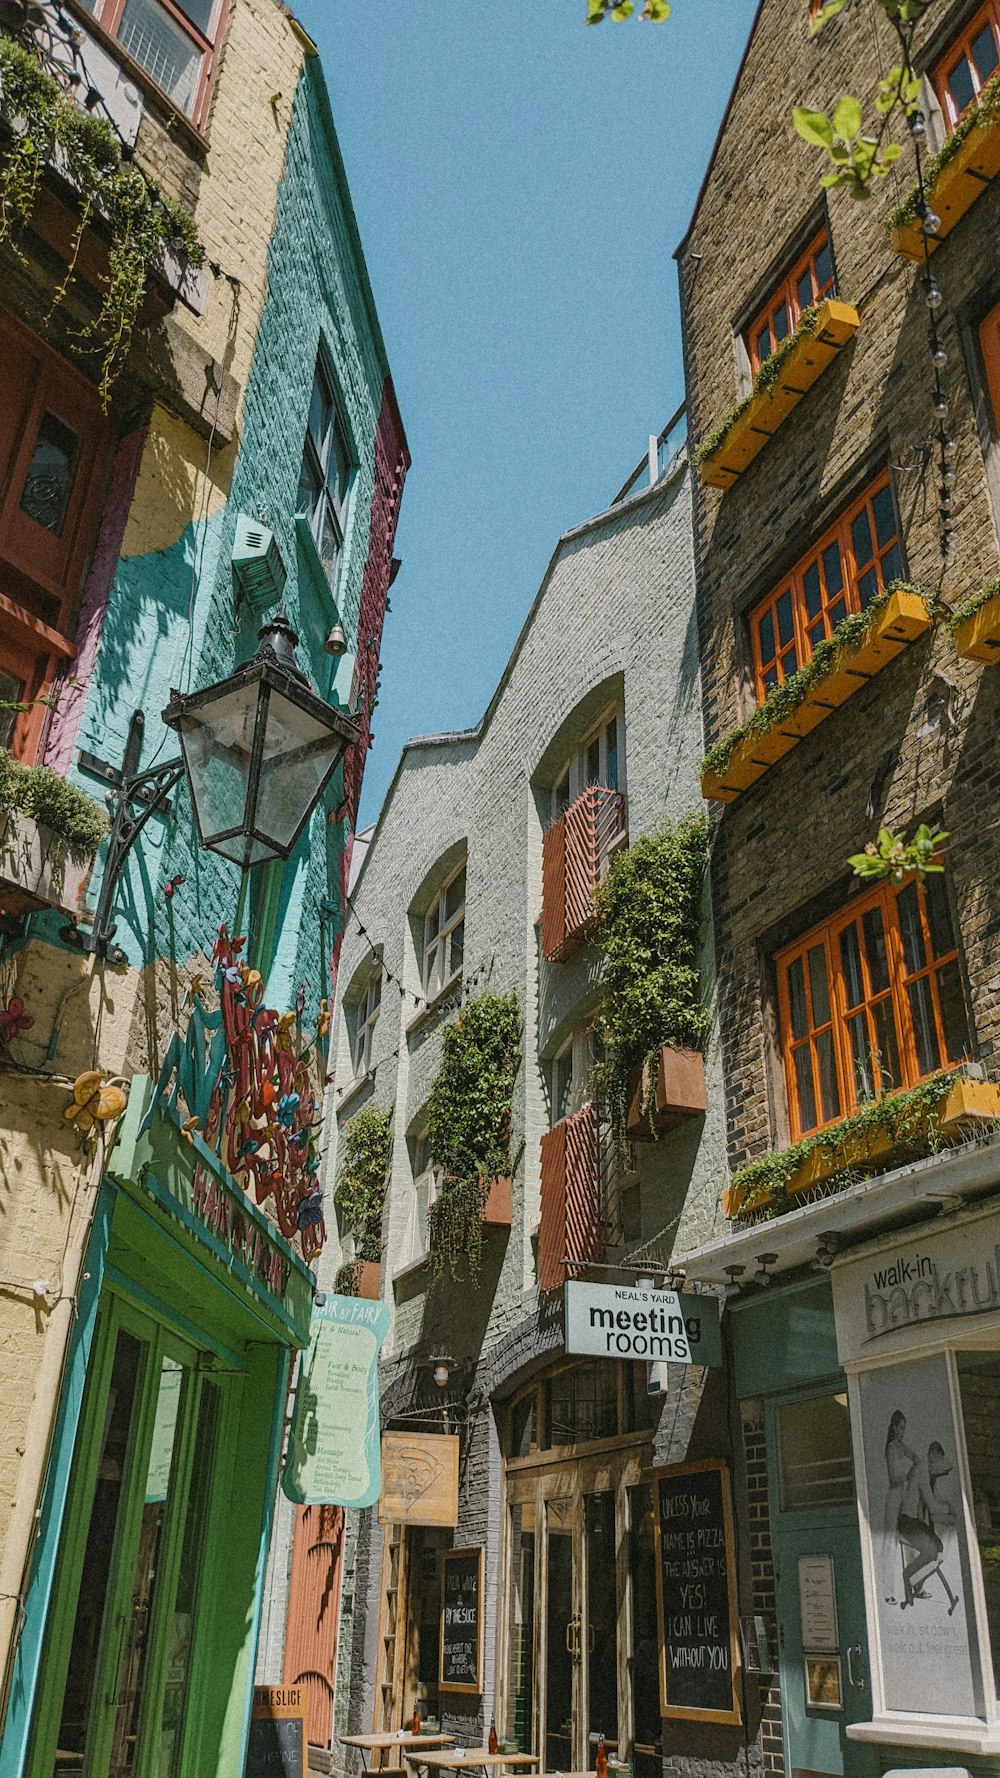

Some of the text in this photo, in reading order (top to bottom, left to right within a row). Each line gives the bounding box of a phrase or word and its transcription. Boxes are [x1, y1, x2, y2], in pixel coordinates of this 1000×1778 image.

[873, 1253, 931, 1289] walk-in
[615, 1290, 675, 1305] NEAL'S YARD
[350, 1303, 383, 1325] FAIRY
[589, 1307, 700, 1343] meeting
[606, 1332, 688, 1358] rooms
[663, 1533, 686, 1550] NAME
[697, 1528, 725, 1548] PIZZA
[663, 1561, 680, 1578] THE
[680, 1584, 707, 1609] YES!
[673, 1615, 692, 1637] CAN
[697, 1615, 719, 1637] LIVE
[669, 1645, 728, 1670] WITHOUT YOU
